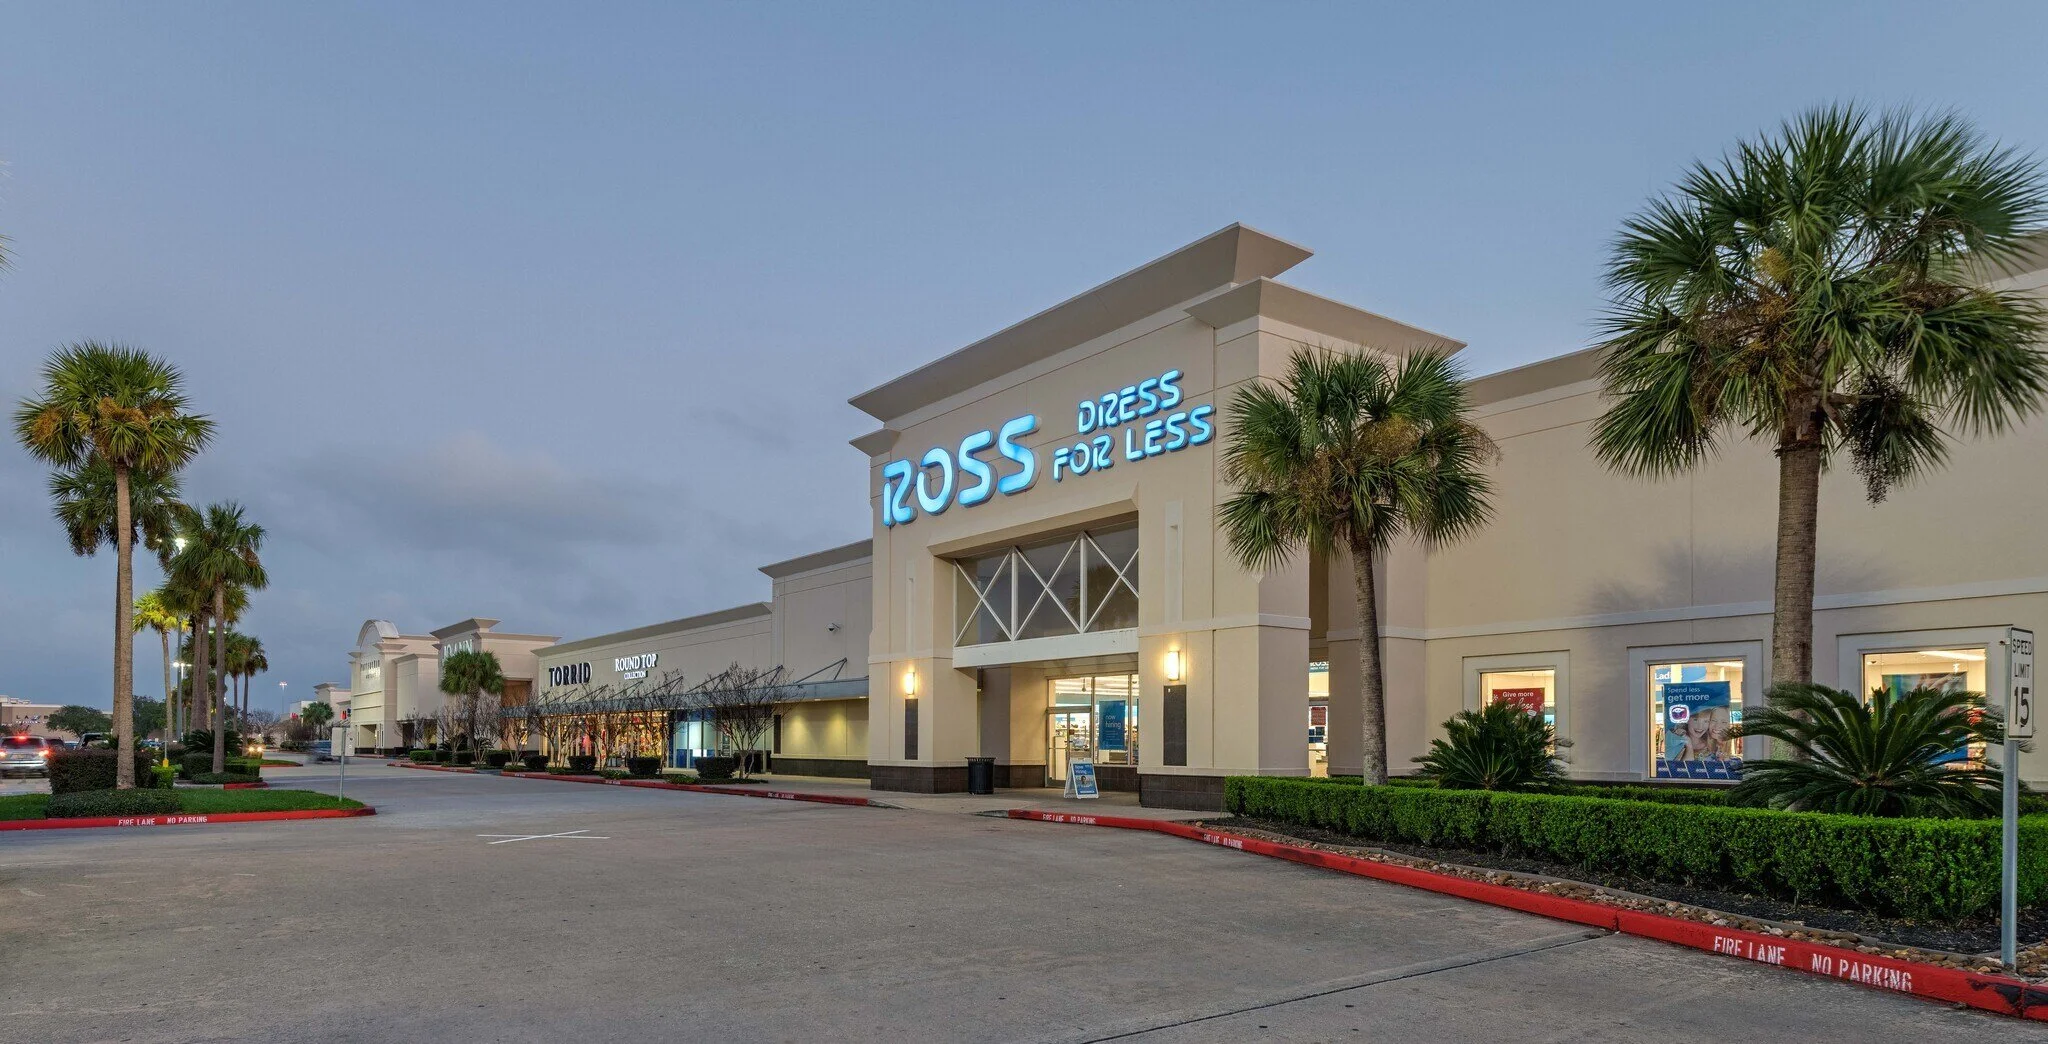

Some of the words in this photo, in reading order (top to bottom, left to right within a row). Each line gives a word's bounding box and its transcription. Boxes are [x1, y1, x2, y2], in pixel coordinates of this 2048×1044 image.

[1078, 368, 1184, 434] DRESS
[1053, 434, 1115, 481] FOR
[1125, 404, 1216, 461] LESS
[883, 413, 1041, 528] ROSS
[2013, 638, 2032, 655] SPEED
[615, 656, 641, 672] ROUND
[641, 653, 658, 668] TOP
[2014, 662, 2030, 678] LIMIT
[549, 661, 592, 687] TORRID
[1655, 671, 1671, 680] Lad
[1667, 694, 1683, 703] get
[2014, 686, 2030, 728] 15
[1105, 720, 1122, 730] hiring
[118, 818, 134, 826] FIRE
[1713, 935, 1742, 956] FIRE
[1749, 942, 1785, 964] LANE
[1812, 953, 1832, 975] NO
[1839, 959, 1913, 991] PARKING
